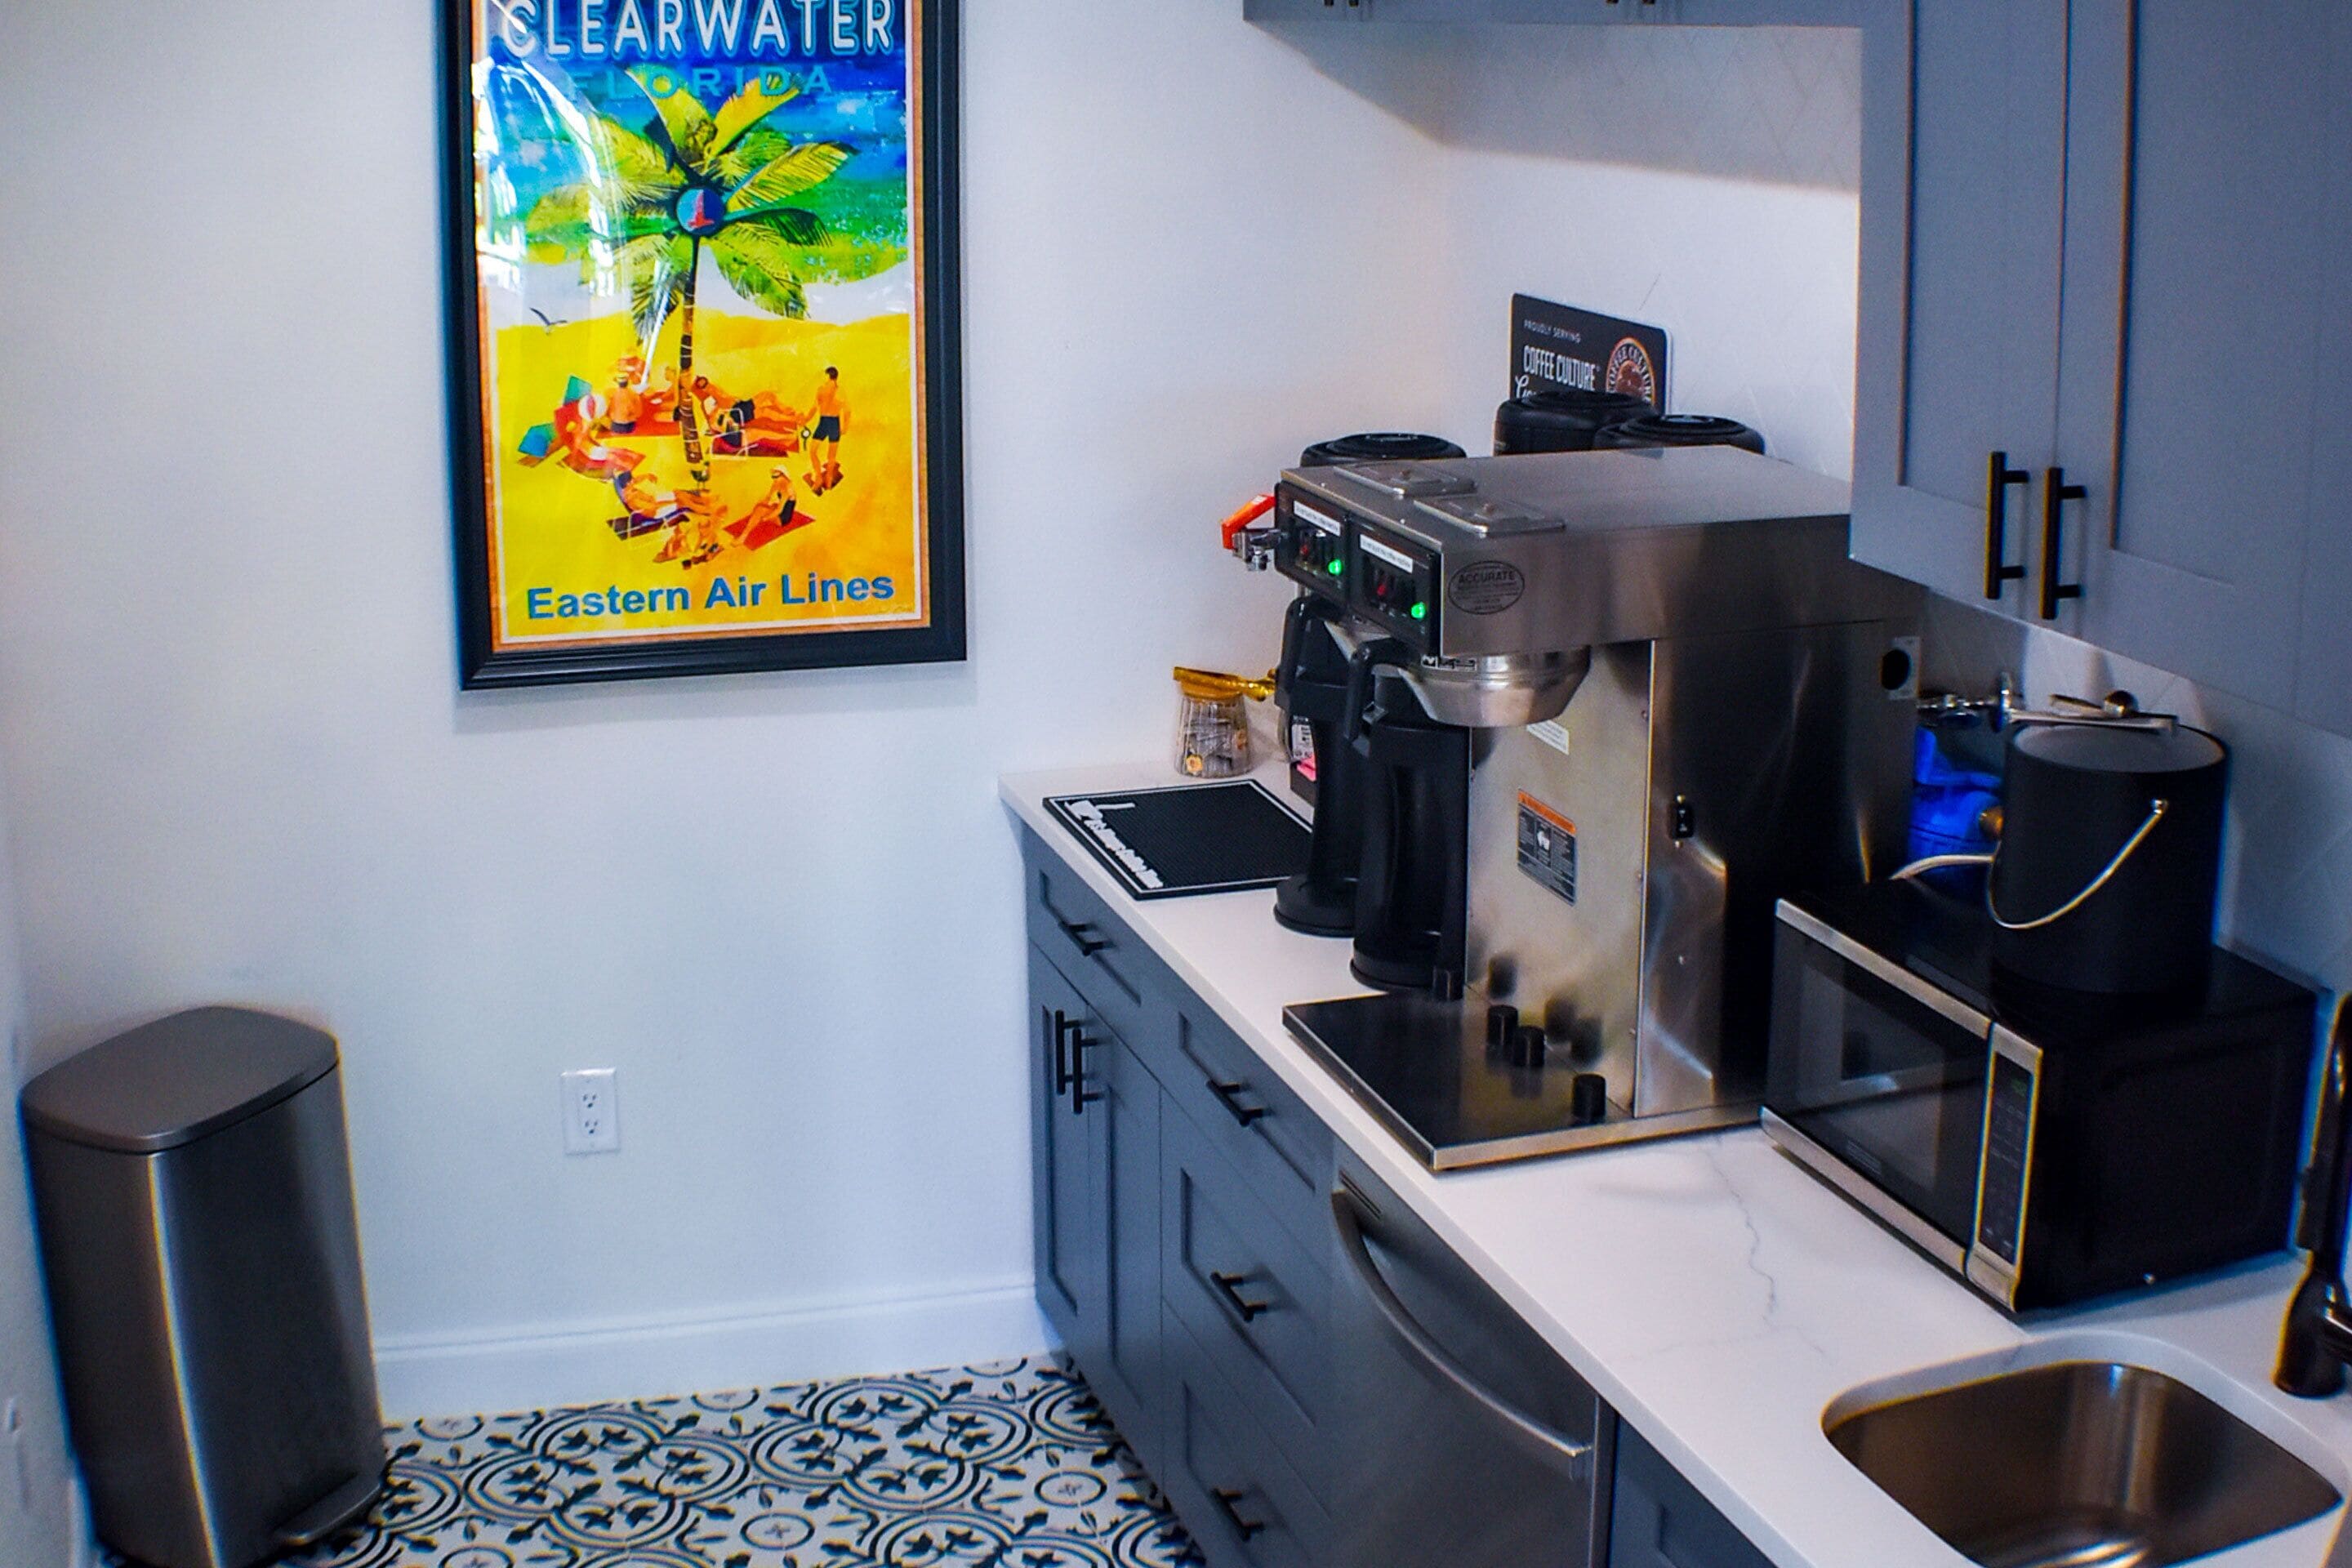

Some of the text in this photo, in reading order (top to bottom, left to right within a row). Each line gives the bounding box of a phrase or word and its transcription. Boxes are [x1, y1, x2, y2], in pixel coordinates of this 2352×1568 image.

[500, 0, 894, 57] CLEARWATER
[572, 65, 832, 99] FLORIDA
[1523, 344, 1555, 381] COFFEE
[1556, 354, 1596, 392] CULTURE
[528, 572, 895, 619] Eastern Air Lines
[1459, 571, 1516, 584] ACCURATE
